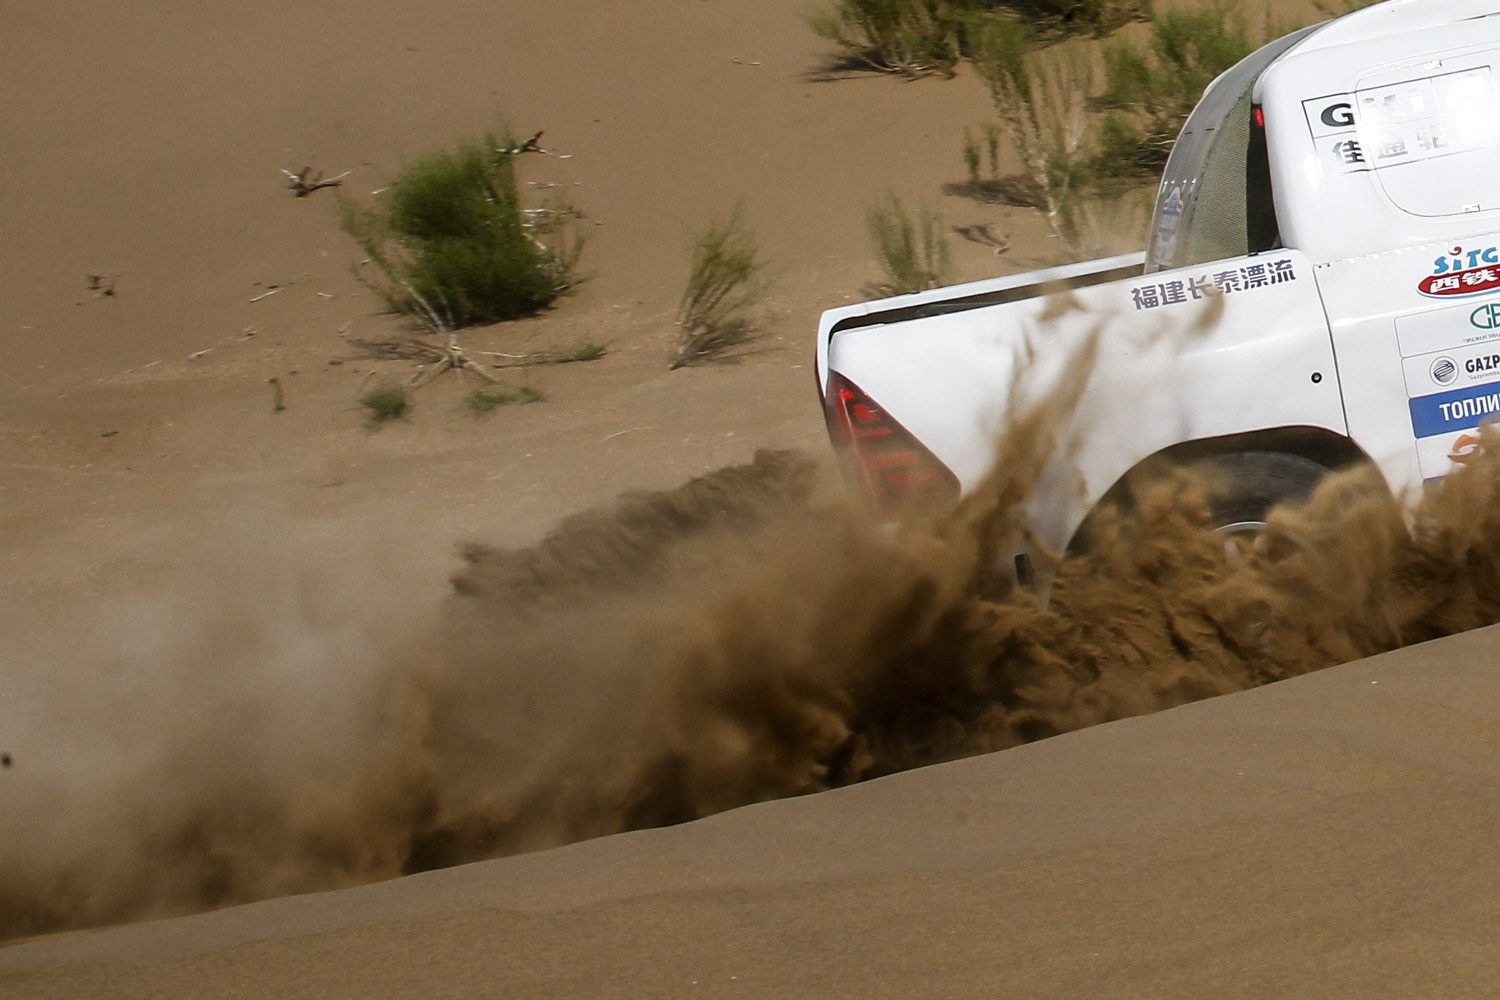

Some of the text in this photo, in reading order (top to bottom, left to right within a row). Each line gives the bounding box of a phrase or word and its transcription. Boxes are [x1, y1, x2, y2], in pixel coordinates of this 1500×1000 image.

[1131, 259, 1297, 310] 福建长泰漂流
